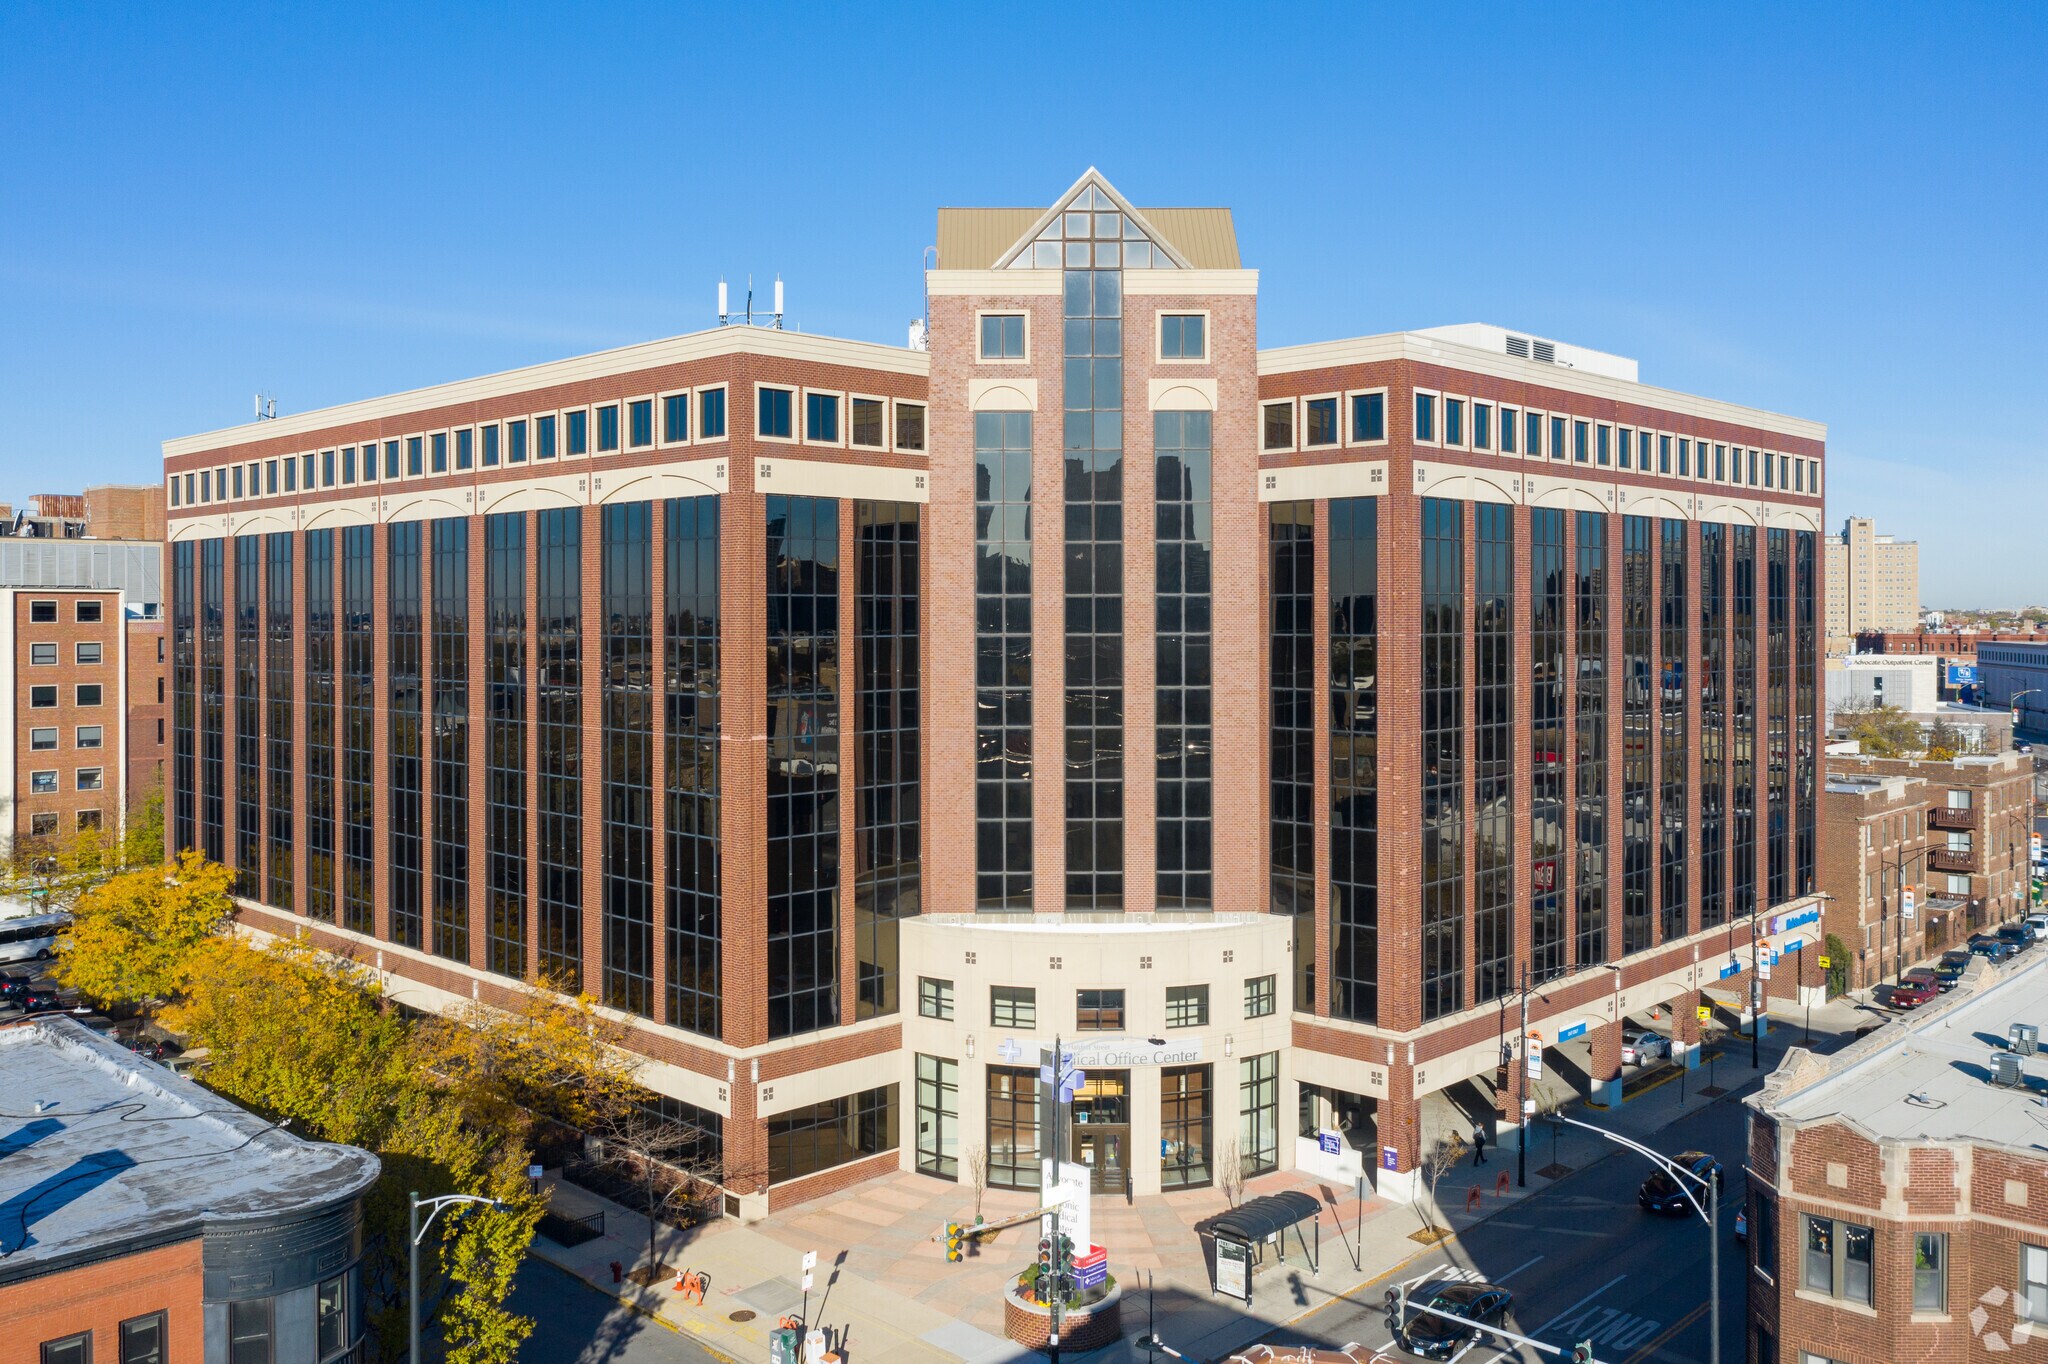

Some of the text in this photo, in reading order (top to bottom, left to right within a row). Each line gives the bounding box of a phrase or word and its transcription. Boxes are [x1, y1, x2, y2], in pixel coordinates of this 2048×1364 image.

[1882, 659, 1913, 667] Outpatient
[1105, 1051, 1148, 1066] Office
[1153, 1050, 1198, 1063] Center
[1046, 1219, 1072, 1234] Cter
[1552, 1305, 1661, 1350] ONLY
